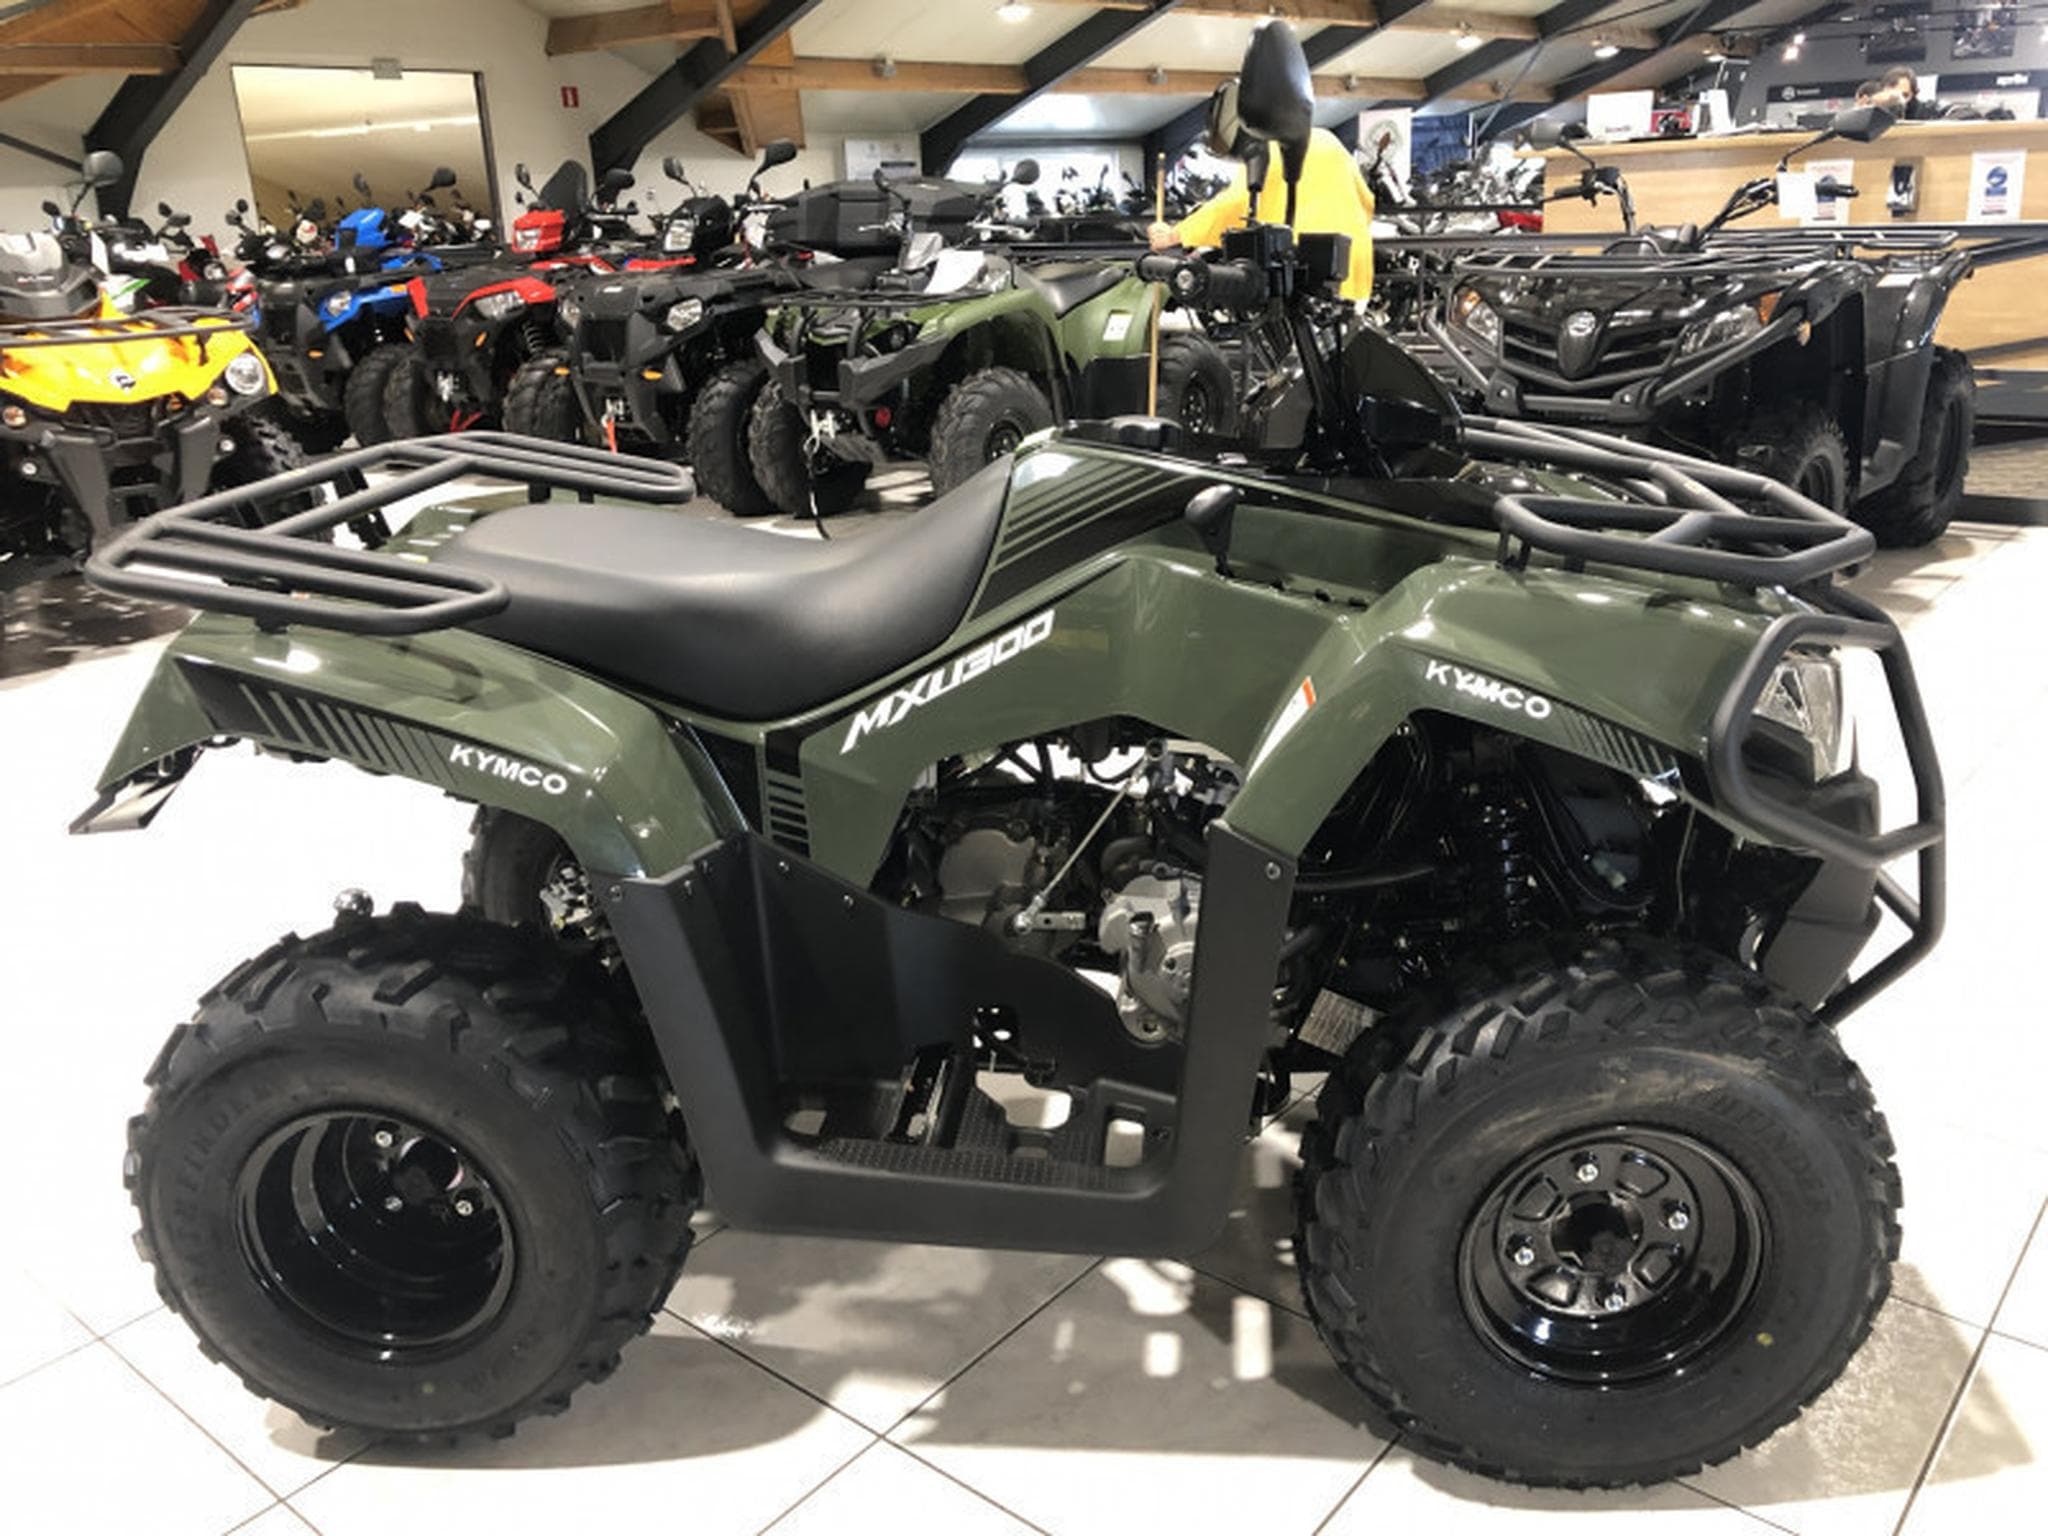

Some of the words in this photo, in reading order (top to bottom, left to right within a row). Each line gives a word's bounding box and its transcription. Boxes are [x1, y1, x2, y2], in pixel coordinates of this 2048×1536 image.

[840, 608, 1055, 755] MXU300
[1425, 659, 1552, 719] KYMCO
[449, 743, 567, 795] KYMCO
